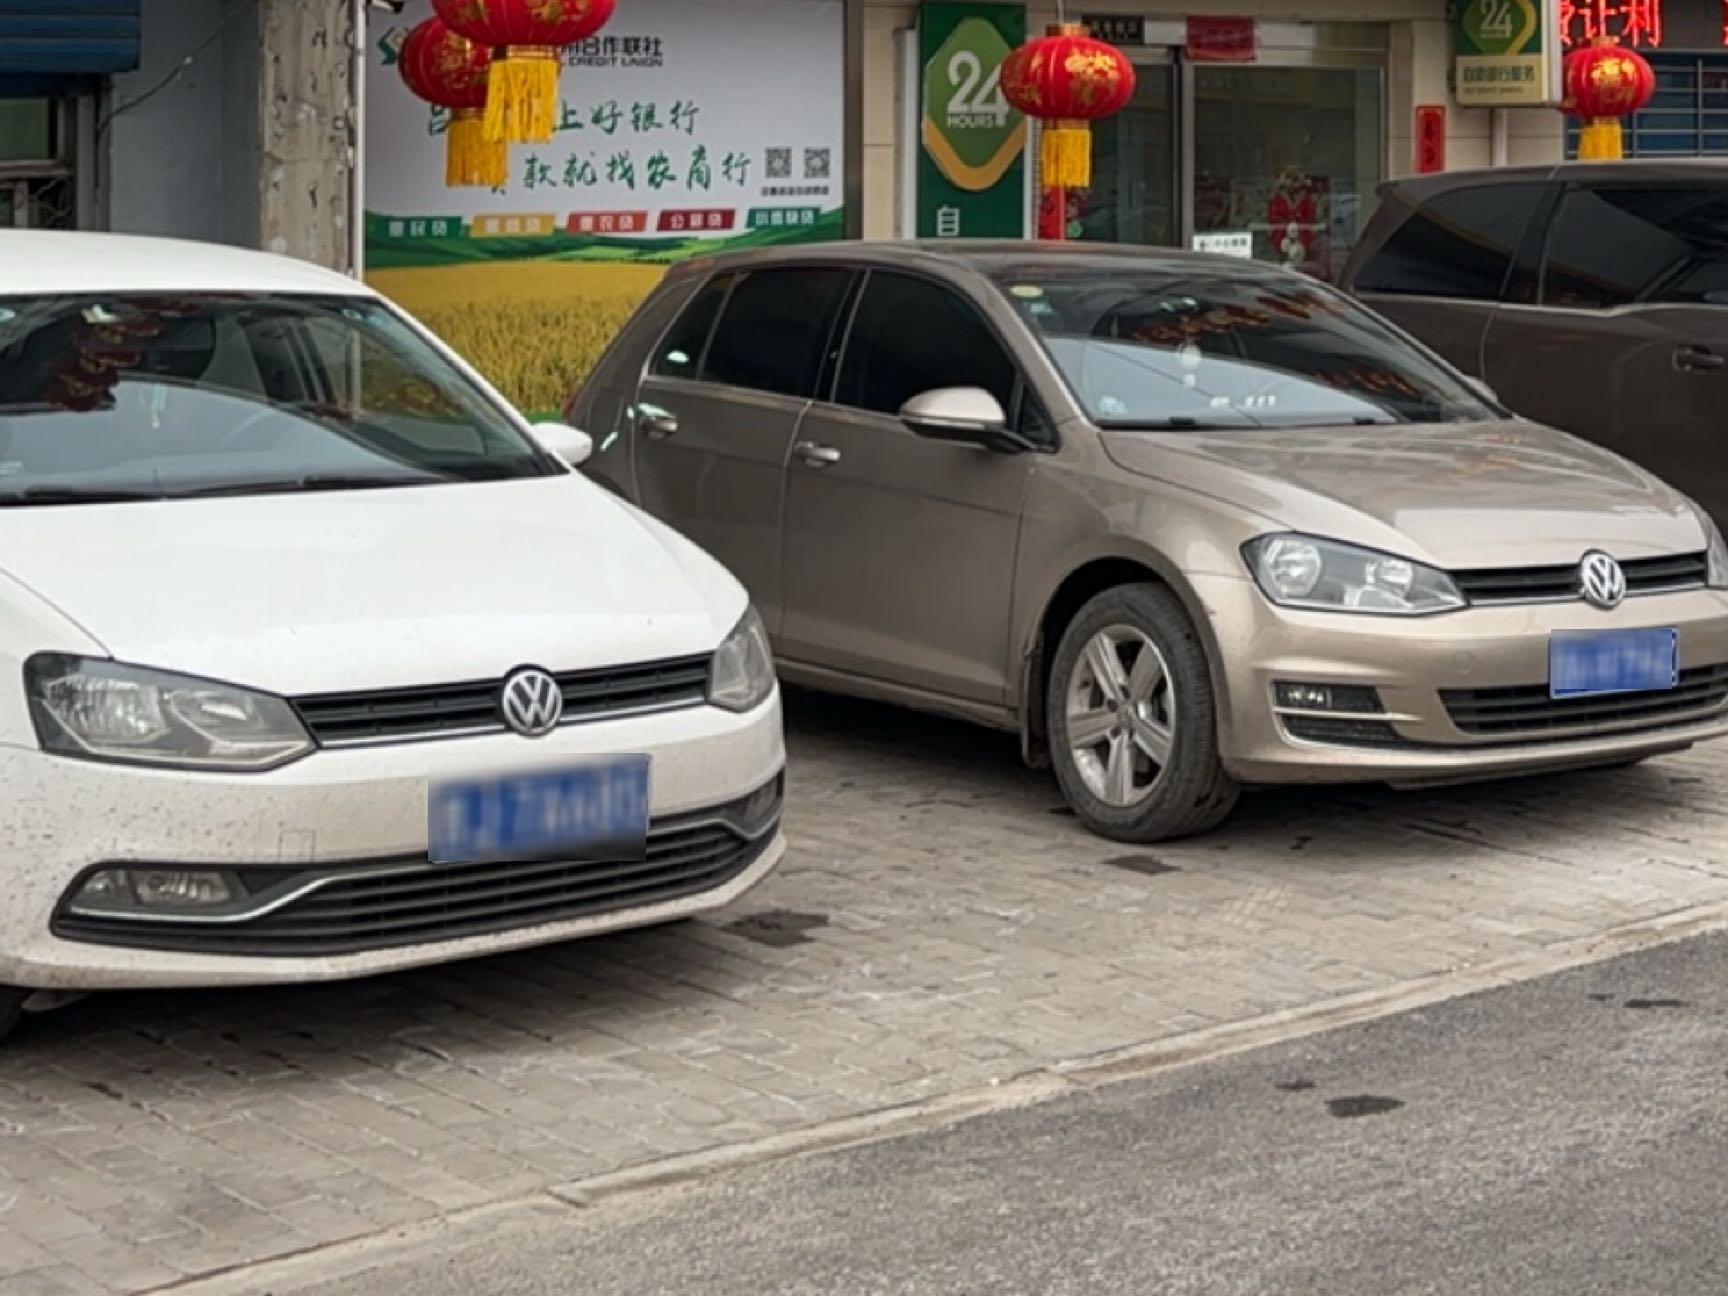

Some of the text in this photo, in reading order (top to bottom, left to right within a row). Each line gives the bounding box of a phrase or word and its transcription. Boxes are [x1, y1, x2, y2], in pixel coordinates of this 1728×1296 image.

[947, 113, 994, 128] HOURS
[490, 141, 753, 197] 款就找农商行
